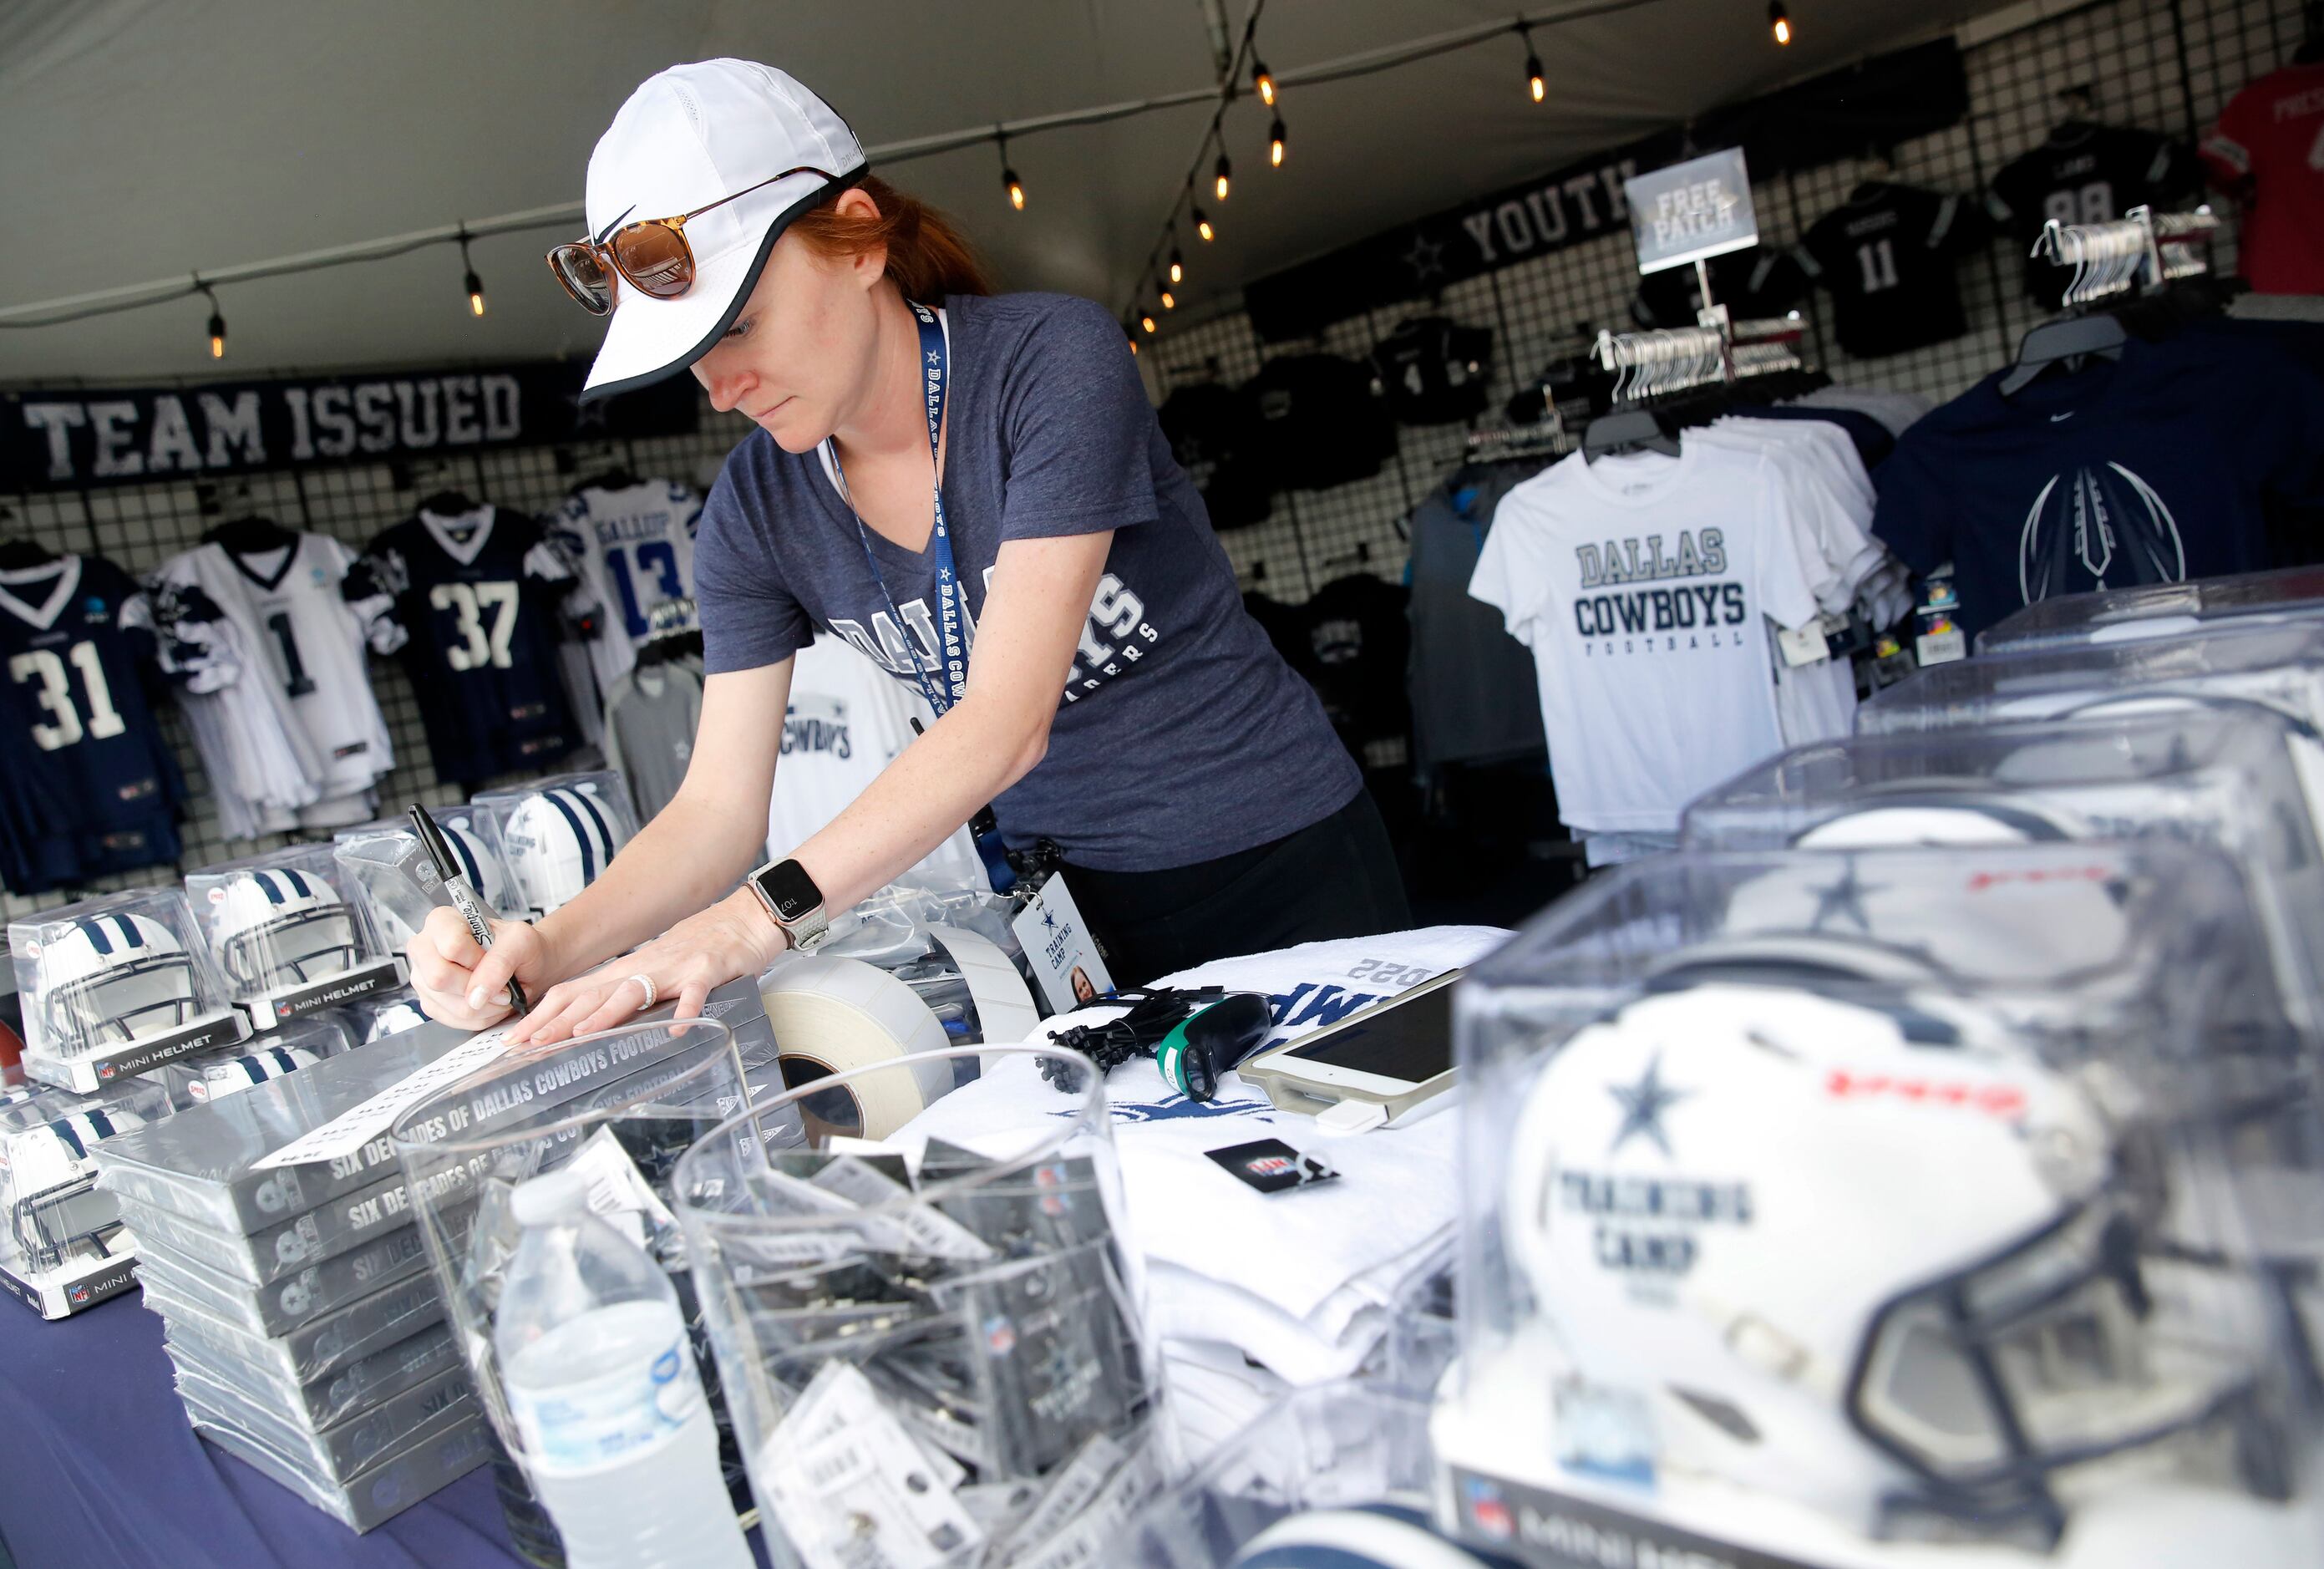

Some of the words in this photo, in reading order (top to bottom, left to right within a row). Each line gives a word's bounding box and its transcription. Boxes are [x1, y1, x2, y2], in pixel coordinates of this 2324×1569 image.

[1464, 160, 1636, 262] YOUTH
[1656, 177, 1722, 216] FREE
[1856, 239, 1899, 293] 11
[23, 390, 266, 481] TEAM
[285, 373, 522, 461] ISSUED
[928, 368, 941, 443] DALLAS
[1576, 527, 1728, 590] DALLAS
[607, 541, 684, 638] 13
[1574, 582, 1746, 639] COWBOYS
[430, 581, 520, 670] 37
[941, 584, 961, 657] DALLAS
[1585, 634, 1744, 658] FOOTBALL
[267, 611, 317, 698] 1
[9, 641, 125, 750] 31
[464, 904, 492, 946] Sharpie
[781, 897, 798, 912] 1:07
[1045, 922, 1073, 958] TRAINING
[1051, 947, 1067, 970] CAMP
[295, 998, 322, 1012] MINI
[323, 978, 376, 1002] HELMET
[119, 1054, 150, 1074] MINI
[152, 1033, 212, 1062] HELMET
[330, 1151, 364, 1181] SIX
[448, 1105, 469, 1131] OF
[473, 1079, 534, 1123] DALLAS
[535, 1048, 608, 1095] COWBOYS
[609, 1027, 677, 1065] FOOTBAL
[348, 1196, 383, 1231] SIX
[1560, 1169, 1757, 1224] TRAINING
[1593, 1223, 1701, 1276] CAMP
[94, 1275, 128, 1295] MINI
